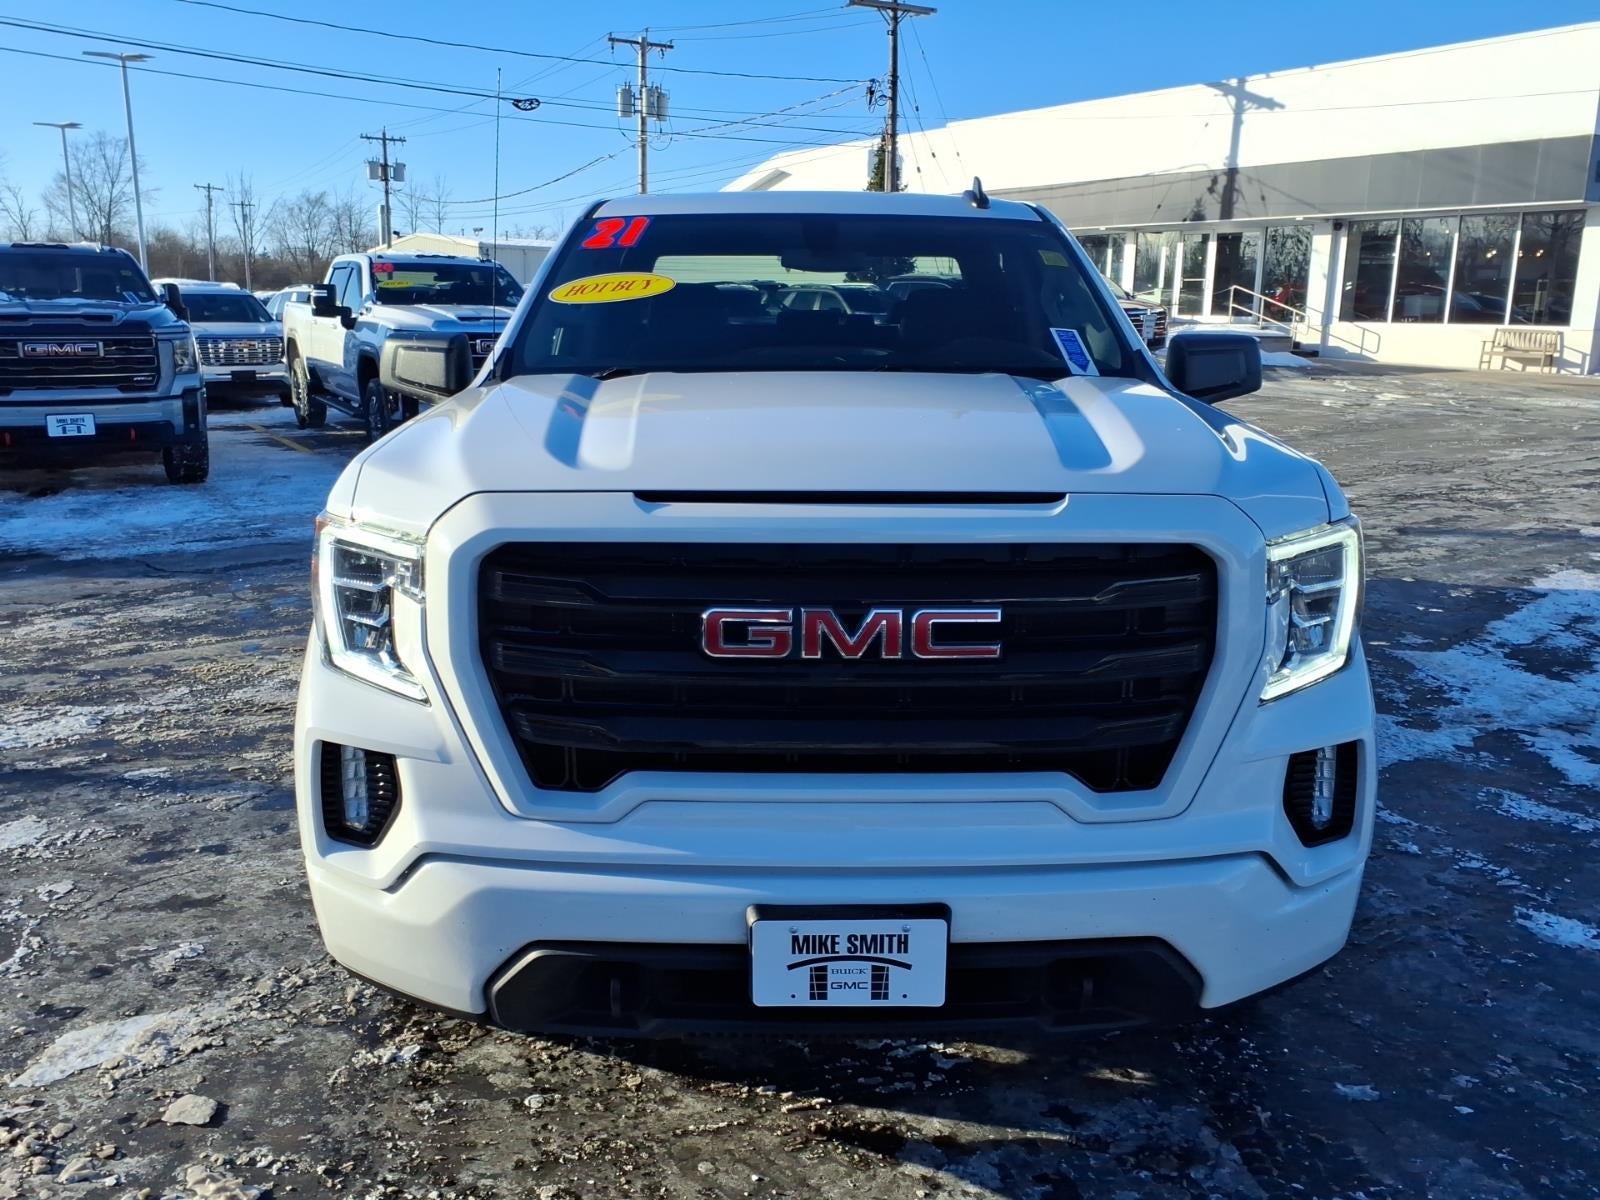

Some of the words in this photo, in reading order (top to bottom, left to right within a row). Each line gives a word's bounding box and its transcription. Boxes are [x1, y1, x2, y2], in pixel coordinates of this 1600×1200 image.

[581, 216, 650, 249] 21
[564, 281, 613, 297] HOT
[611, 278, 661, 292] BUY
[24, 343, 97, 356] GMC
[701, 608, 1002, 659] GMC
[791, 934, 840, 954] MIKE
[846, 933, 909, 954] SMITH
[830, 981, 869, 990] GMC
